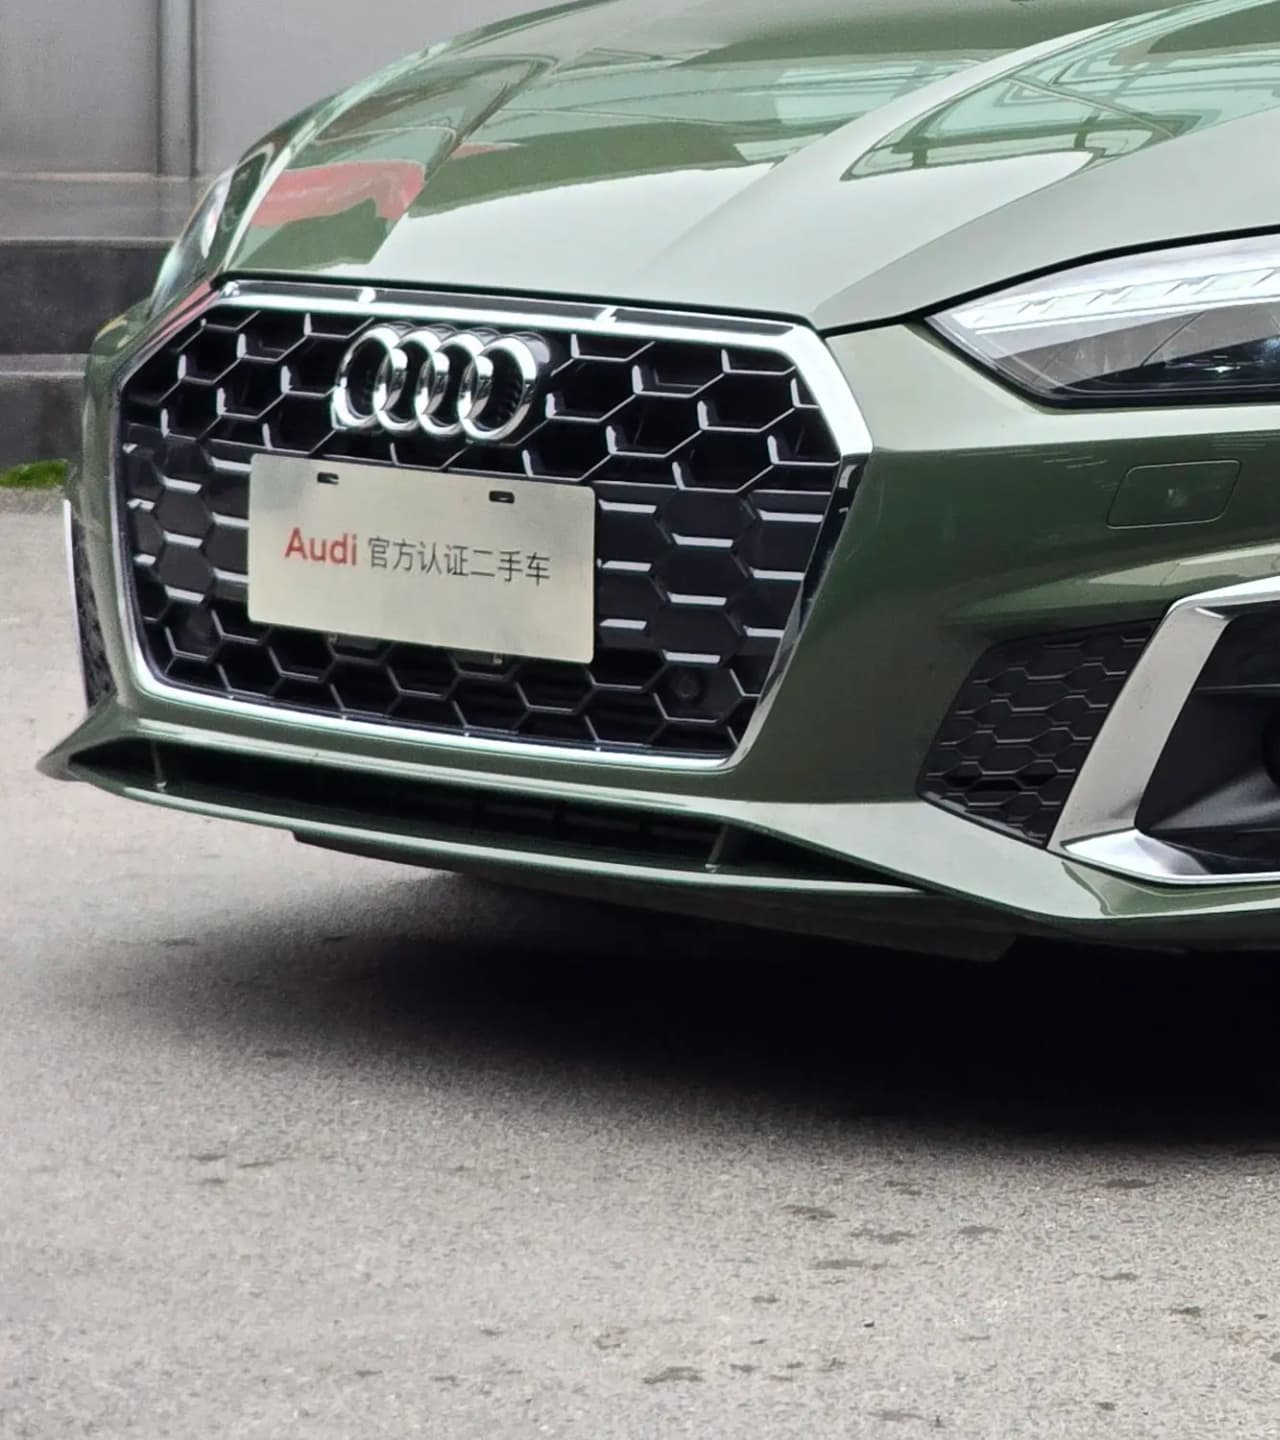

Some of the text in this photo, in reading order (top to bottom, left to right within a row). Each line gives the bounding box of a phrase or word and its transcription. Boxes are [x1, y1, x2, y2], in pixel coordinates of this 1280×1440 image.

[284, 527, 551, 587] Audi 官方认证二手车
